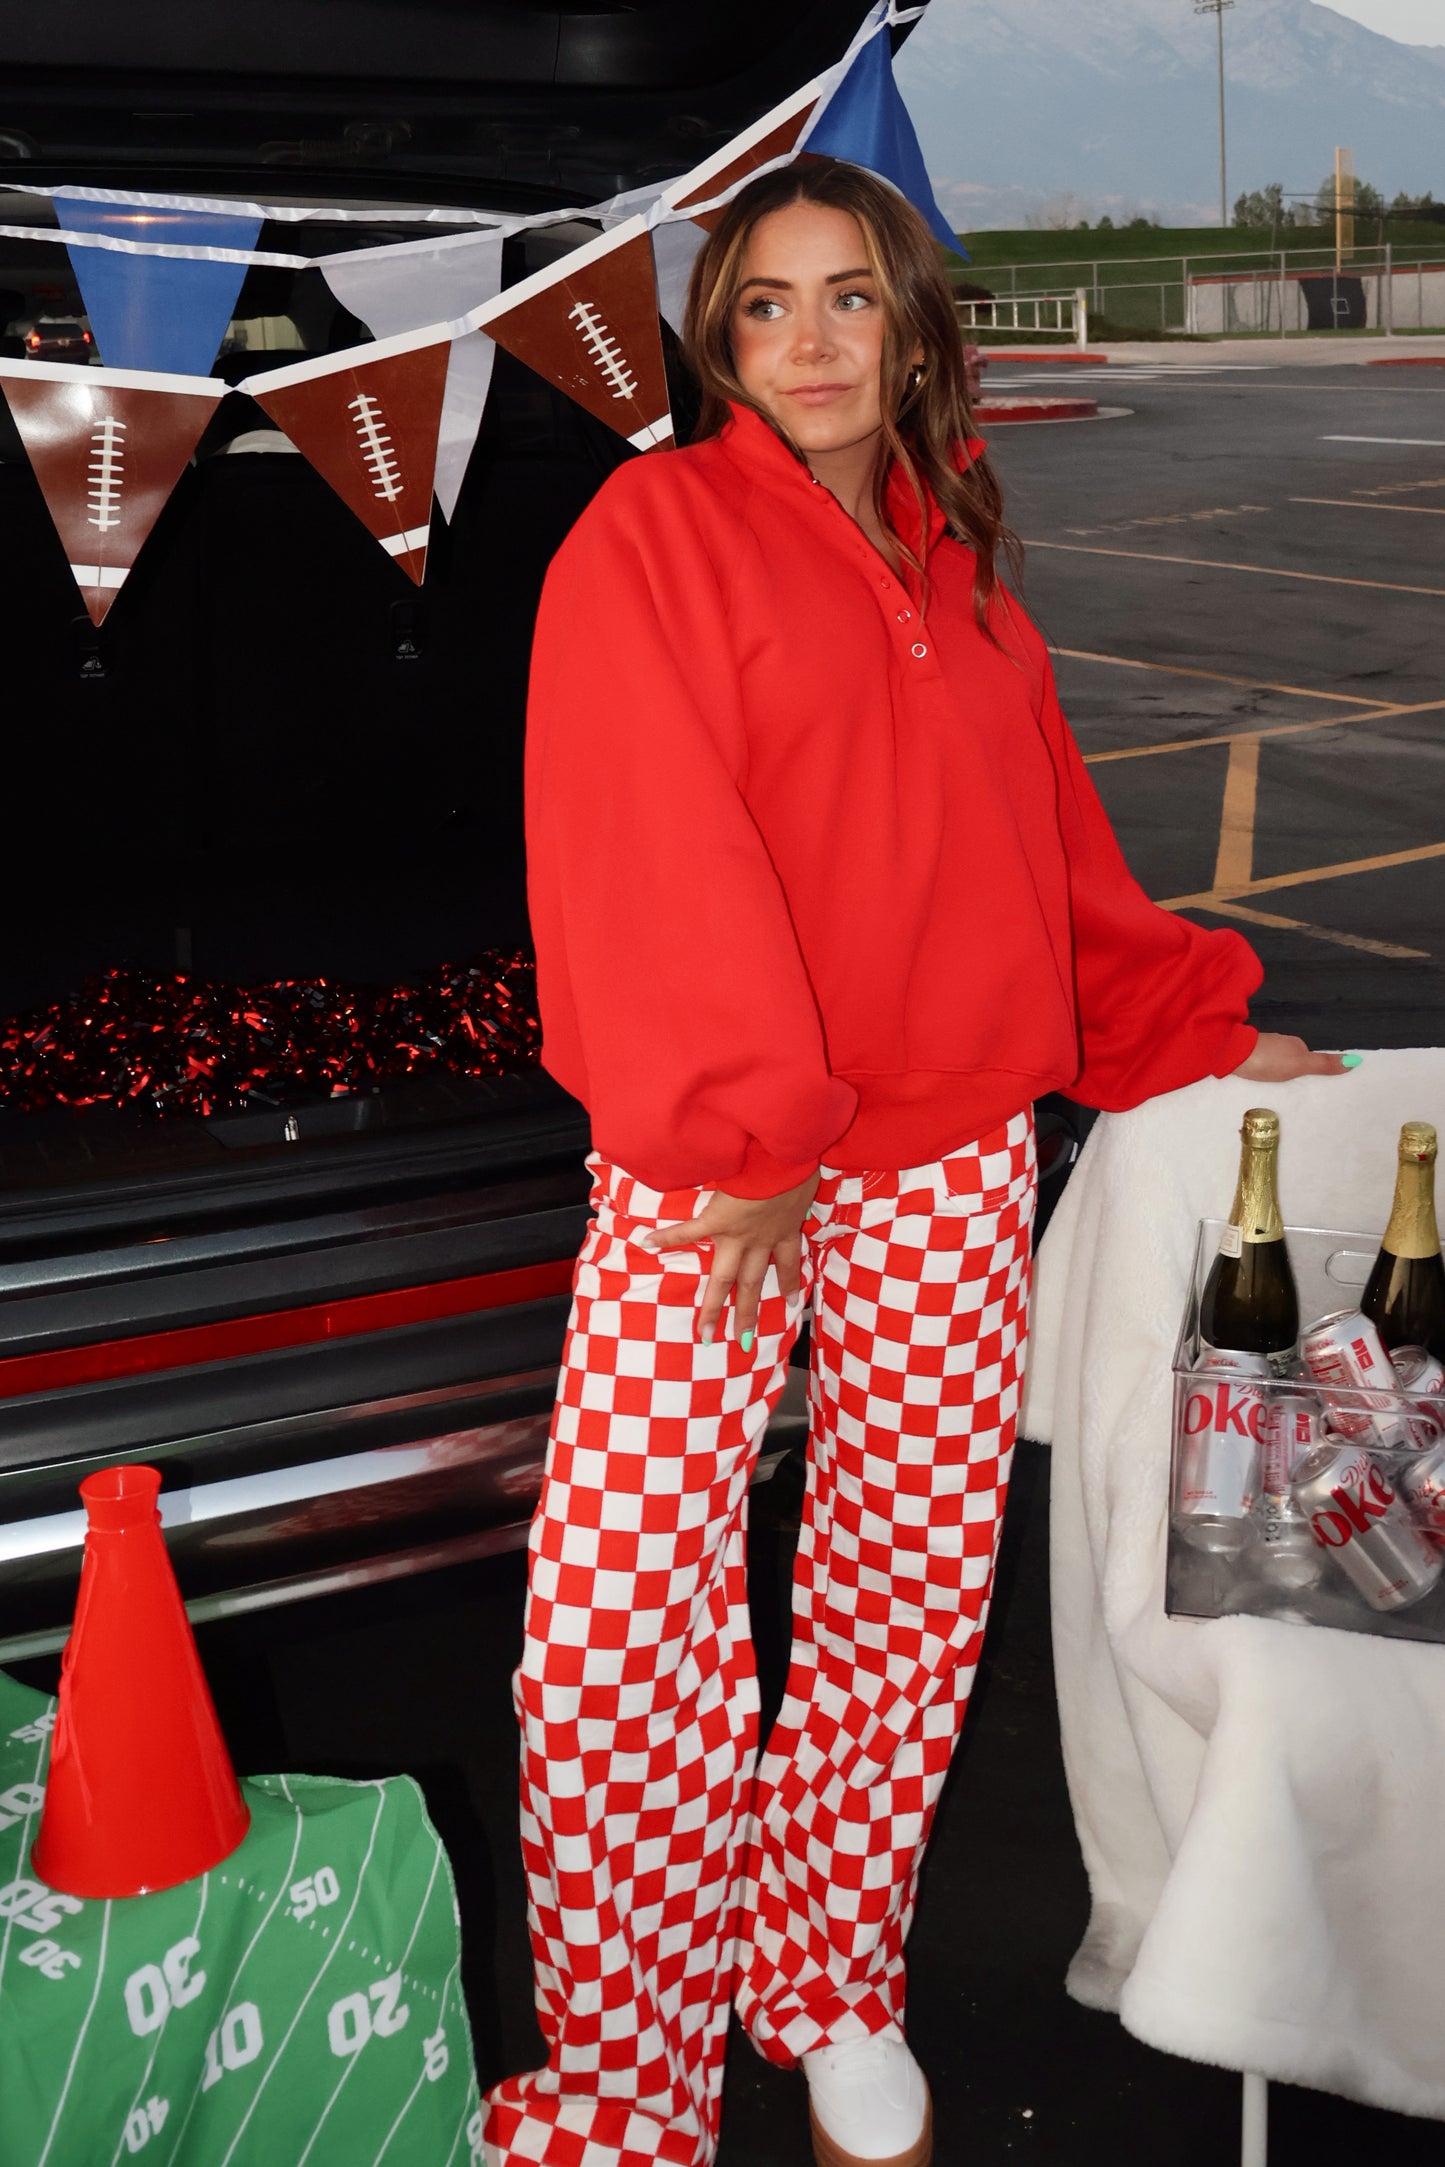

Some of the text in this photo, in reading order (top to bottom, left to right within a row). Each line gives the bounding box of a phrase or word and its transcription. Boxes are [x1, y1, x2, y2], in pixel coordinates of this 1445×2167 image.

[1311, 1463, 1396, 1549] oke
[0, 1879, 83, 1934] 50
[289, 1866, 340, 1923] 50
[19, 1939, 81, 1980] 30
[124, 1936, 207, 2038] 30
[327, 1970, 410, 2057] 20
[124, 2095, 170, 2154] 40
